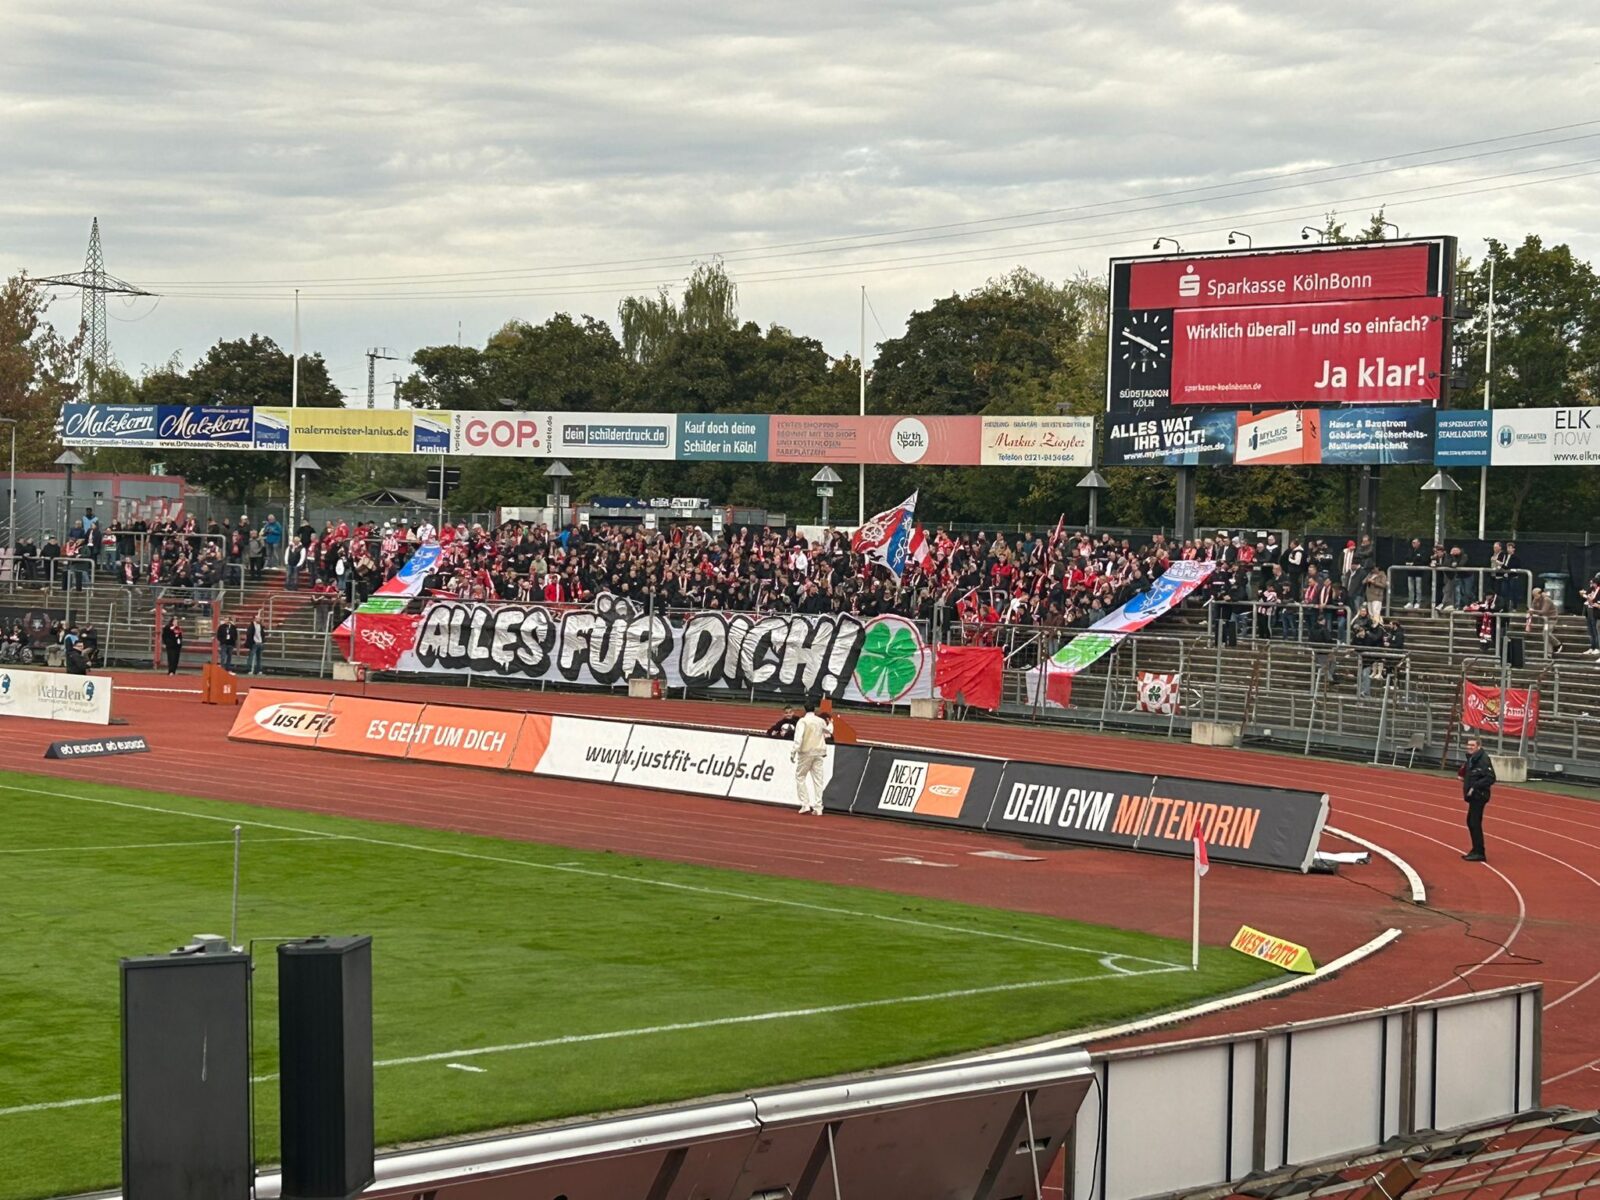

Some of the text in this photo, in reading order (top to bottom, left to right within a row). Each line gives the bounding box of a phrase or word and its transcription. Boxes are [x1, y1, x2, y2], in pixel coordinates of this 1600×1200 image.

[1207, 273, 1372, 298] Sparkasse KölnBonn
[1186, 322, 1243, 340] Wirklich
[1247, 319, 1296, 338] überall
[1312, 321, 1340, 335] und
[1343, 323, 1362, 334] so
[1366, 315, 1429, 333] einfach?
[1314, 357, 1426, 388] Ja klar!
[1120, 388, 1169, 398] SÜDSTADION
[1133, 398, 1155, 408] KÖLN
[66, 405, 154, 436] Malzkorn
[159, 407, 250, 439] Malzkorn
[685, 421, 756, 435] Kauf doch deine
[1110, 416, 1193, 440] ALLES WAT
[1365, 420, 1407, 428] Baustrom
[1555, 409, 1592, 429] ELK
[294, 425, 409, 437] malermeister-lanius.de
[465, 420, 540, 448] GOP.
[565, 427, 665, 442] dein schilderdruck.de
[988, 432, 1037, 448] Markus
[1134, 429, 1206, 451] IHR VOLT!
[1259, 427, 1288, 440] MYLIUS
[1554, 431, 1592, 447] now
[684, 440, 757, 454] Schilder in Köln!
[901, 440, 924, 449] park
[1328, 442, 1409, 450] Multimediatechnik
[998, 453, 1023, 461] Telefon
[417, 593, 866, 702] ALLES FÜR DICH!
[260, 709, 304, 729] Just
[366, 719, 507, 752] ES GEHT UM DICH
[585, 744, 775, 782] www.justfit-clubs.de
[890, 764, 924, 786] NEXT
[883, 785, 916, 807] DOOR
[1003, 782, 1261, 849] DEIN GYM MITTENDRIN
